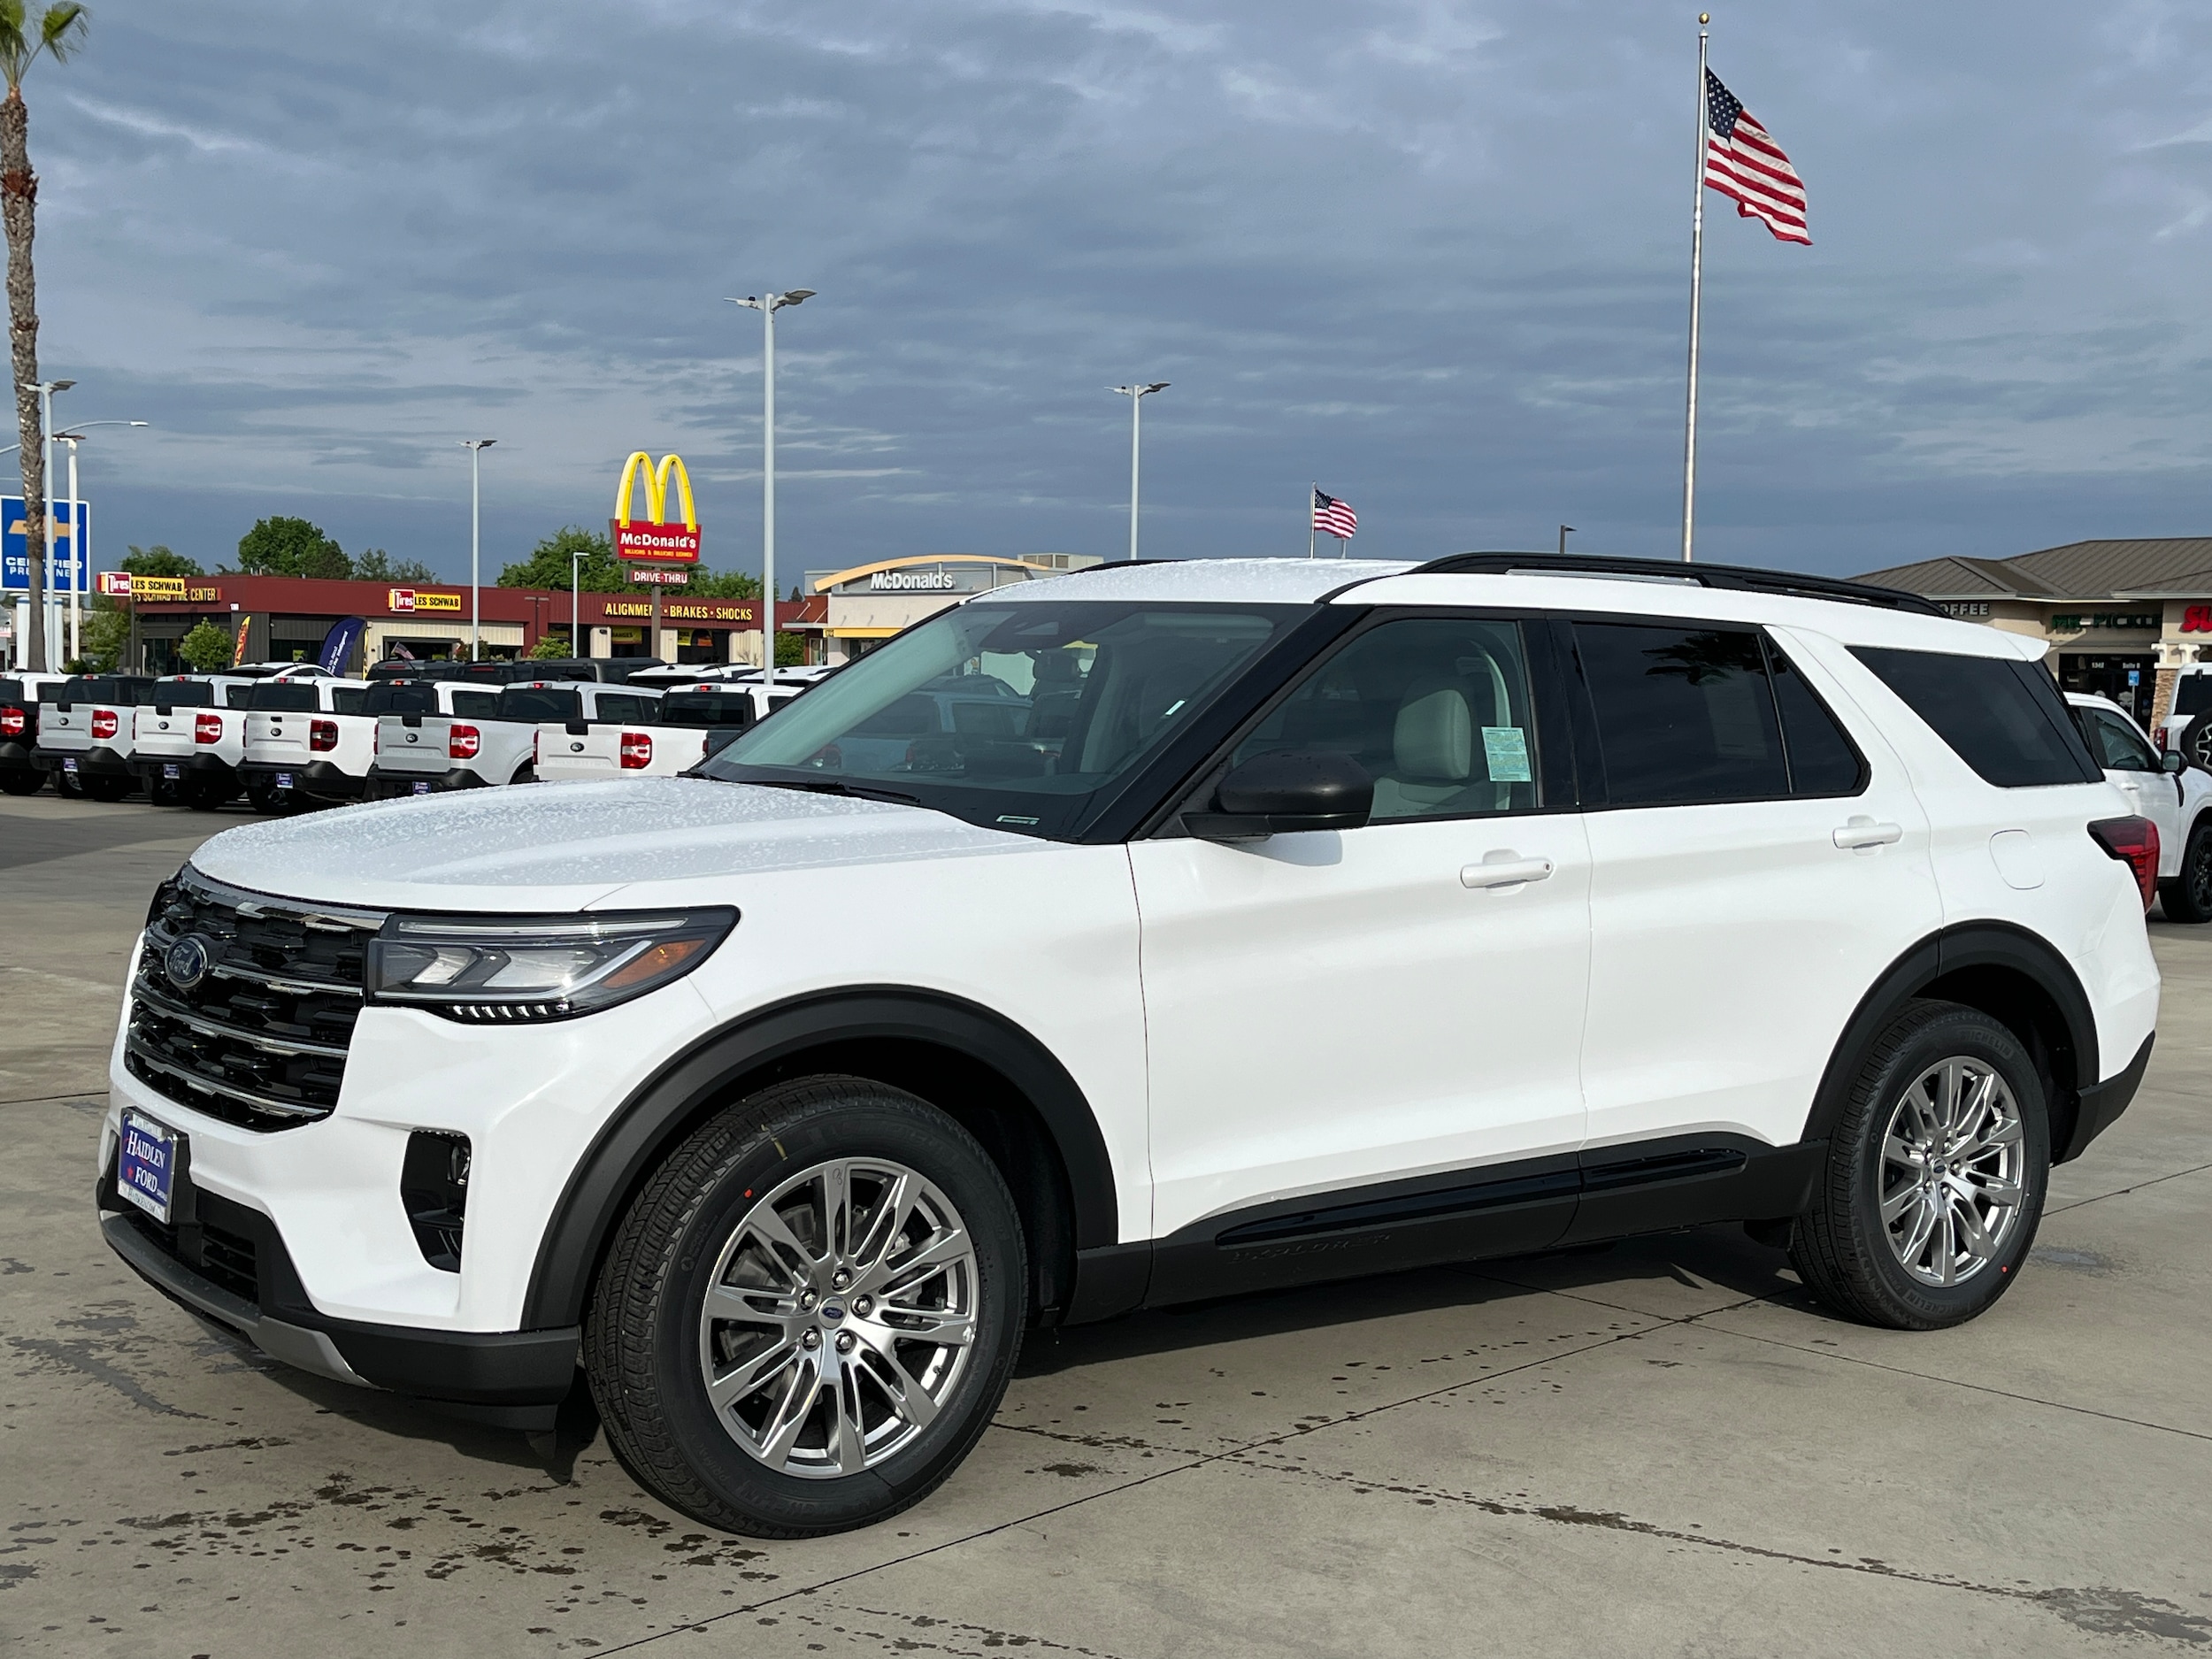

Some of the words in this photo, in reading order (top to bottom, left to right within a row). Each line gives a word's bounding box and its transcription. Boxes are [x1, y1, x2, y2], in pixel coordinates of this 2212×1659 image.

[620, 532, 696, 549] McDonald's
[109, 575, 129, 592] Tires
[132, 580, 145, 590] LES
[149, 580, 182, 592] SCHWAB
[871, 572, 953, 589] McDonald's
[190, 588, 216, 602] CENTER
[414, 597, 426, 606] LES
[429, 597, 459, 607] SCHWAB
[670, 605, 708, 618] BRAKES
[716, 607, 752, 621] SHOCKS
[127, 1130, 166, 1170] HAIDLEN
[134, 1165, 157, 1194] FORD
